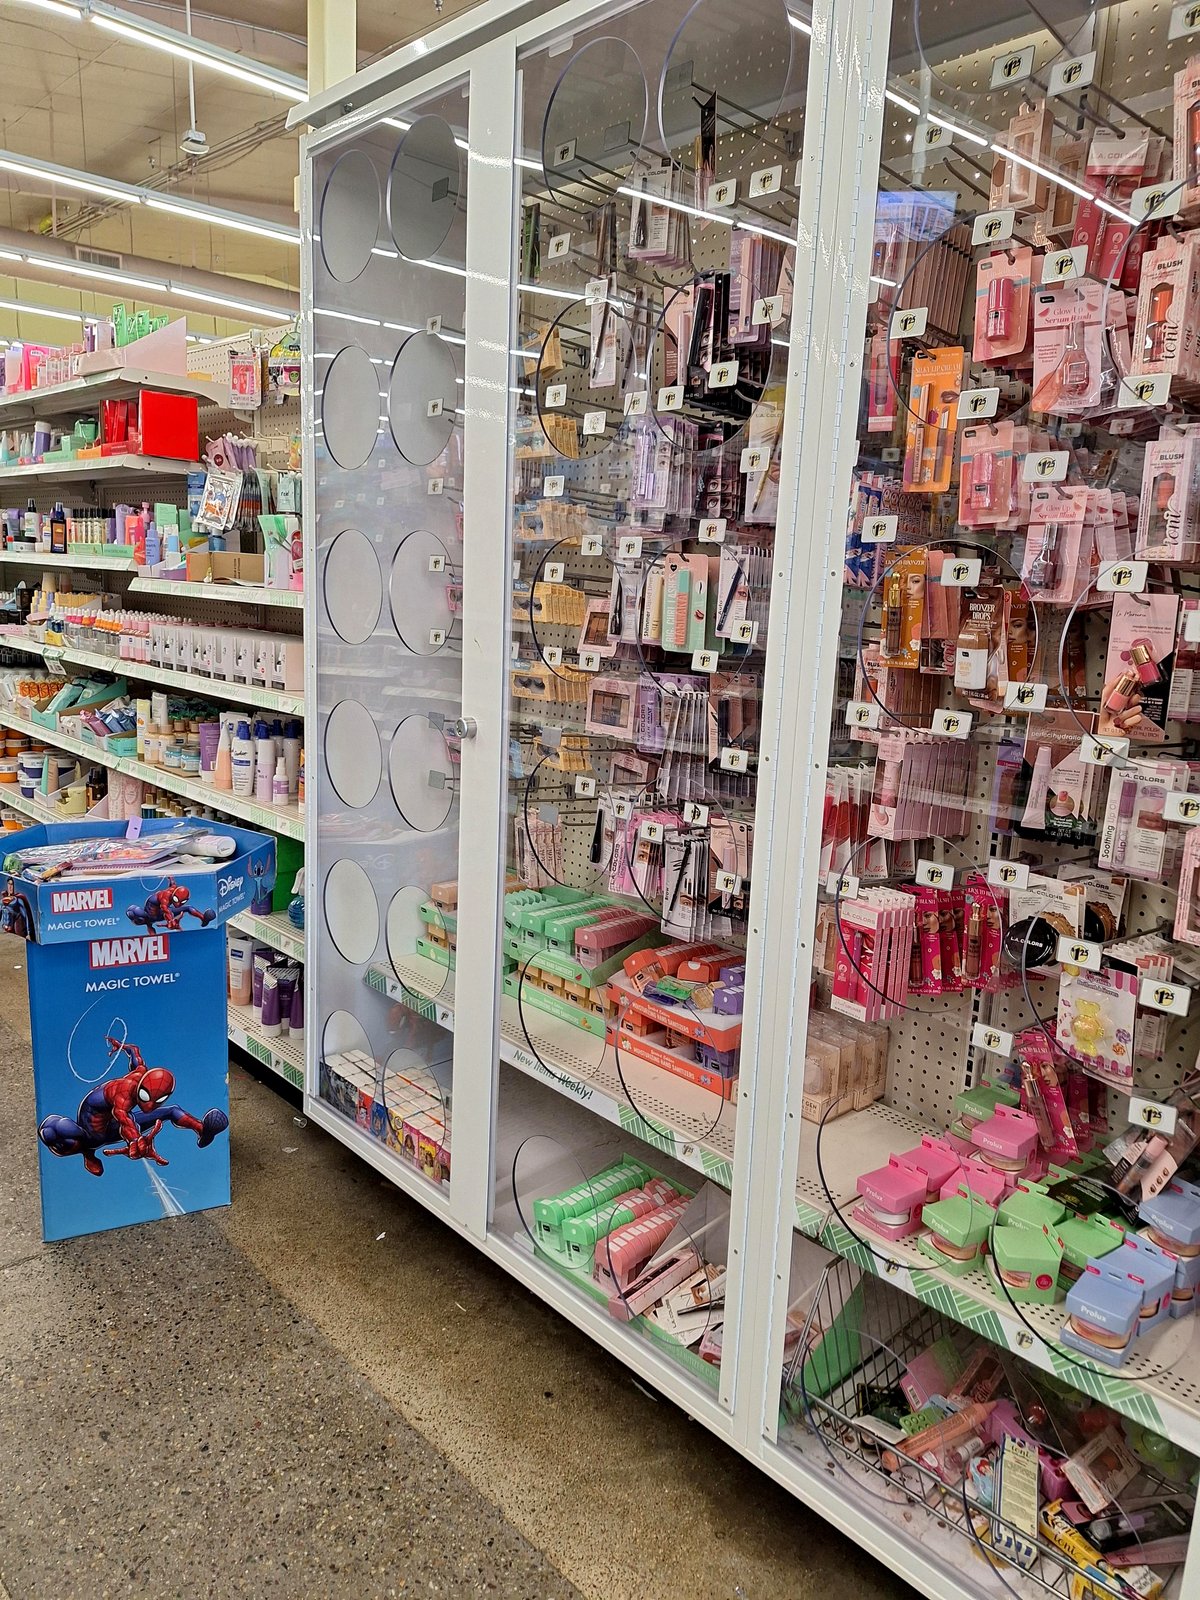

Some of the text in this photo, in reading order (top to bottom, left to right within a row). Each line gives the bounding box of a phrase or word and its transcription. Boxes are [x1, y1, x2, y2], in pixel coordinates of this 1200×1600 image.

[1158, 260, 1183, 270] BLUSH
[1162, 322, 1179, 359] ioni
[667, 574, 676, 602] LASHES
[970, 603, 995, 612] BRONZER
[972, 612, 991, 620] DROPS
[1032, 732, 1081, 740] perfecthydratio
[1134, 774, 1165, 783] COLORS
[1102, 826, 1115, 858] Soothing
[53, 890, 112, 913] MARVEL
[48, 921, 81, 931] MAGIC
[1020, 938, 1043, 947] COLORS
[92, 936, 167, 967] MARVEL
[85, 978, 132, 992] MAGIC
[513, 1050, 594, 1100] New Items Weekly!
[965, 1103, 983, 1116] Prolux
[982, 1137, 1003, 1150] Prolux
[866, 1187, 883, 1201] Prolux
[931, 1218, 949, 1234] Prolux
[1151, 1214, 1174, 1231] Prolux
[1080, 1305, 1107, 1323] Prolux
[1011, 1445, 1030, 1457] ioni
[1052, 1533, 1077, 1556] ioni
